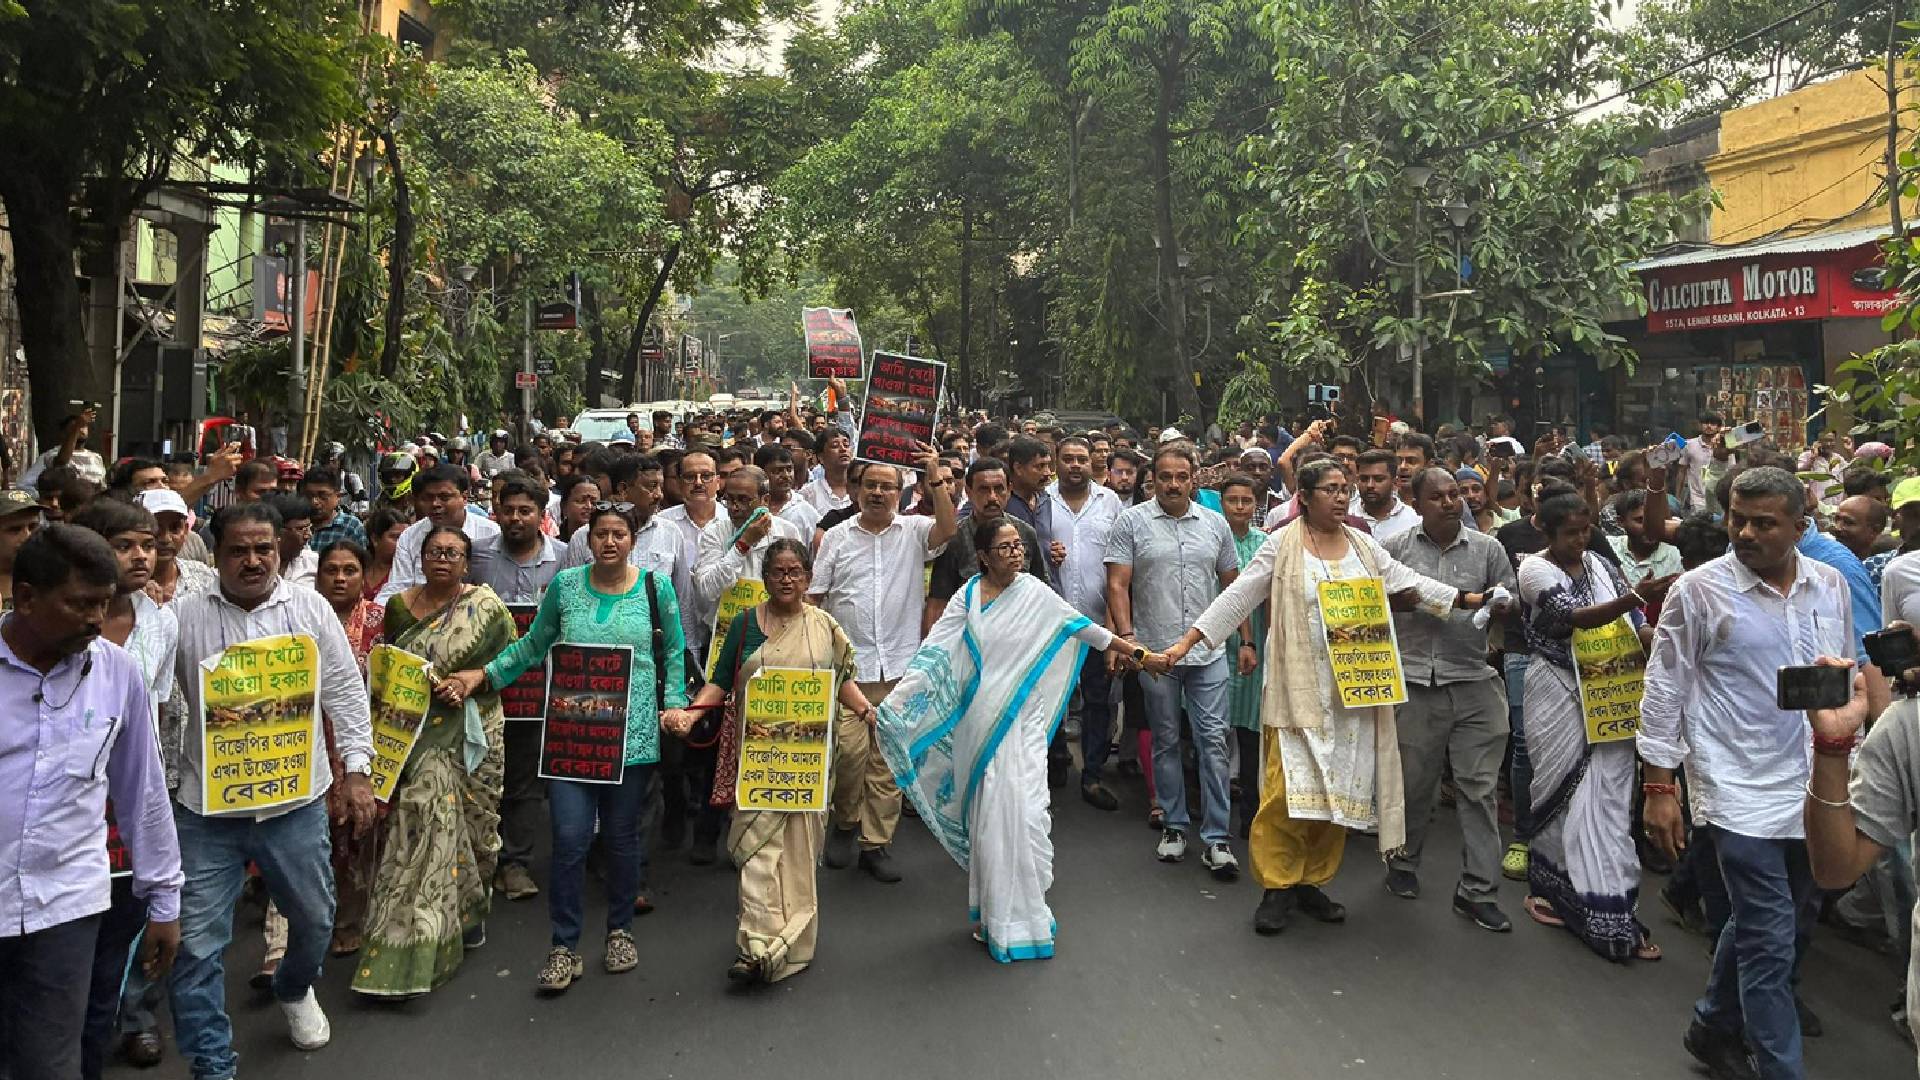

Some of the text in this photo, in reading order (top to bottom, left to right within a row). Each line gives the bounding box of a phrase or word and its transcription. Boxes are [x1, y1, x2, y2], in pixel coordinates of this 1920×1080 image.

[1649, 264, 1815, 312] CALCUTTA MOTOR
[1687, 316, 1711, 327] LENIN
[1712, 312, 1745, 324] SARANI,
[1747, 307, 1787, 321] KOLKATA
[1794, 305, 1805, 316] 13
[880, 360, 904, 376] আমি
[873, 377, 905, 392] খাওয়া
[866, 445, 914, 464] বেকা
[1326, 582, 1354, 602] আমি
[1326, 605, 1360, 619] খাওয়া
[1576, 638, 1613, 654] খাওয়া
[218, 642, 306, 672] আমি খেটে
[559, 648, 623, 673] আমি খেটে
[1333, 648, 1367, 666] বিজেপির
[211, 669, 311, 696] খাওয়া হকার
[553, 672, 585, 690] খাওয়া
[589, 675, 625, 691] হকার
[755, 673, 822, 696] আমি খেটে
[393, 682, 428, 708] হকার
[1344, 684, 1394, 702] বেকার
[750, 698, 825, 718] খাওয়া হকার
[1597, 715, 1641, 737] বেকা
[213, 730, 308, 759] বিজেপির আমলে
[746, 745, 821, 765] বিজেপির আমলে
[211, 751, 308, 783] এখন উচ্ছেদ হওয়া
[550, 758, 614, 778] বেকার
[743, 768, 821, 787] এখন উচ্ছেদ হওয়া
[223, 773, 300, 804] বেকার
[749, 787, 814, 805] বেকার
